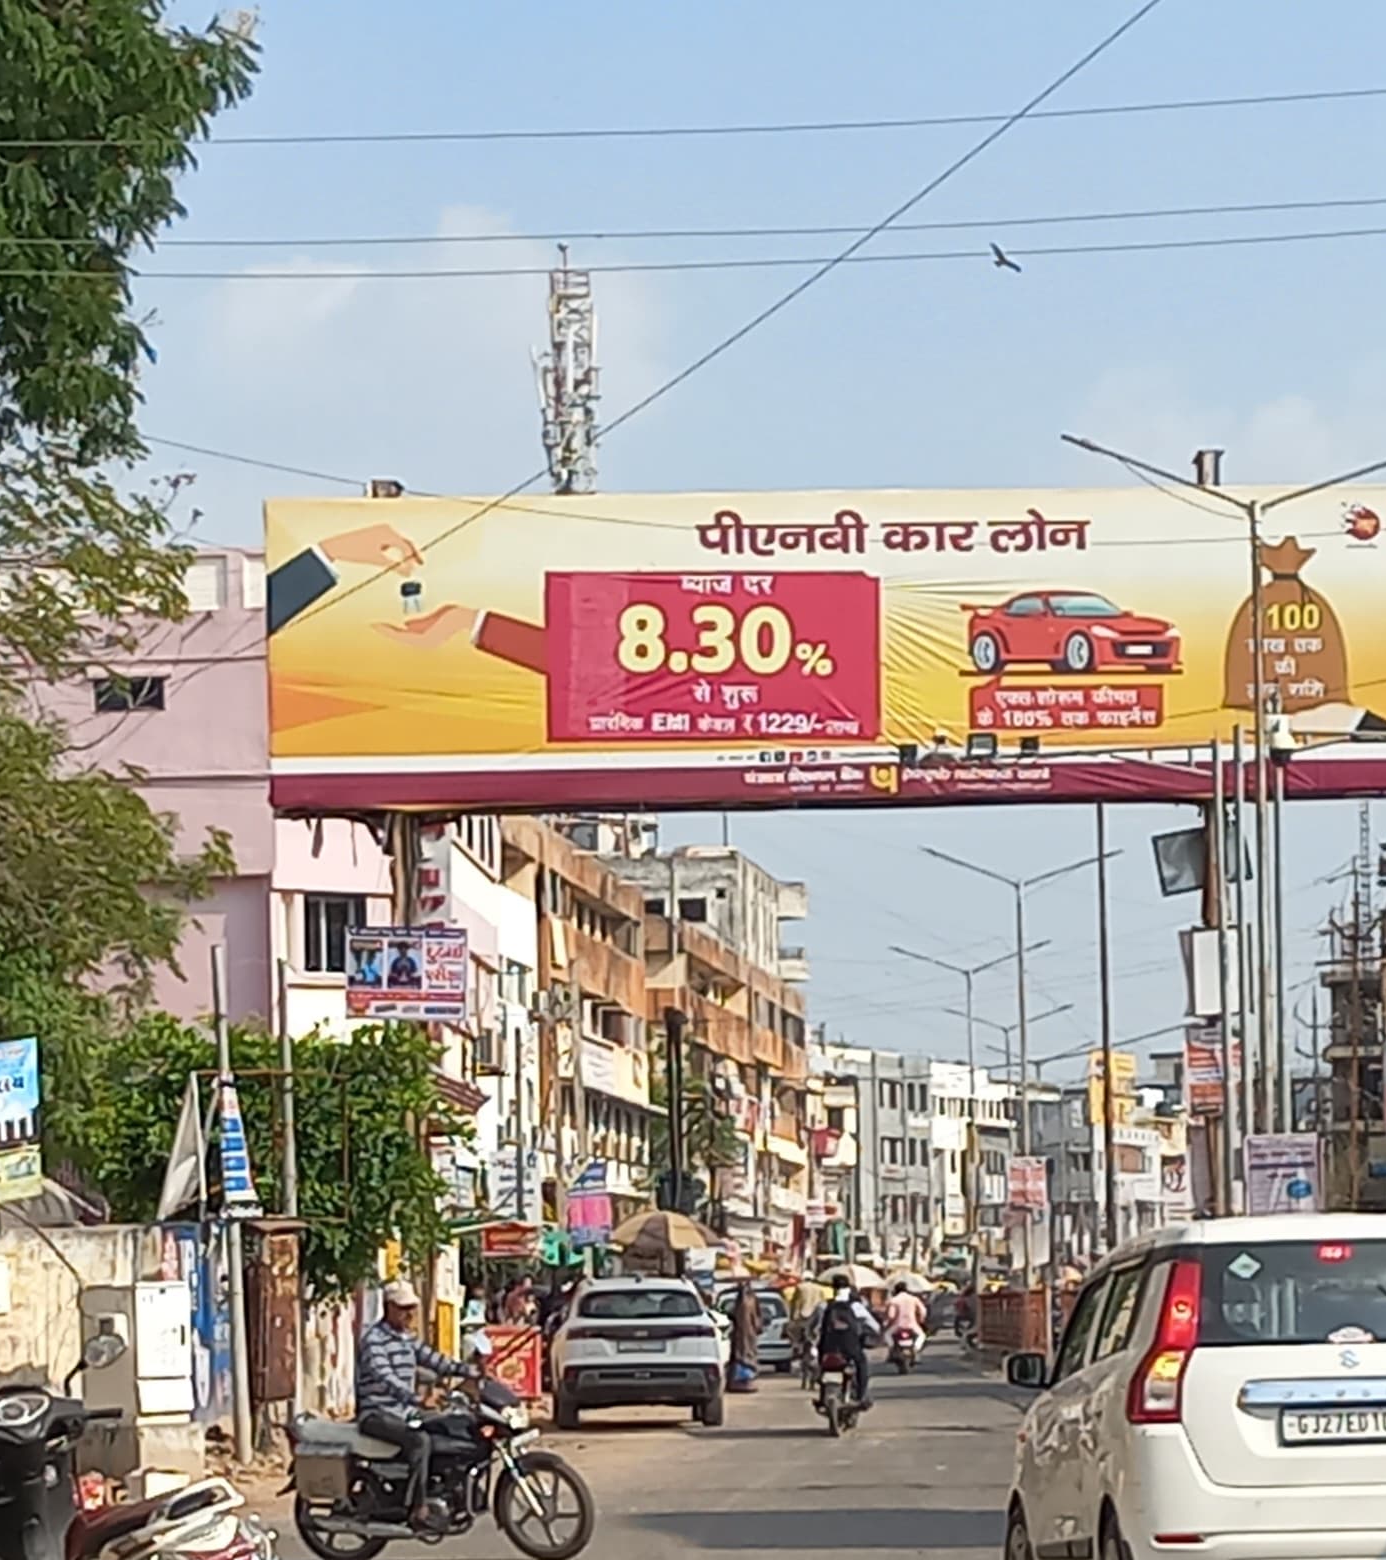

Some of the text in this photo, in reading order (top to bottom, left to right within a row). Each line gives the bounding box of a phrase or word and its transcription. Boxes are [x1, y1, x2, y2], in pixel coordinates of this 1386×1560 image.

[695, 508, 1090, 556] पीएनबी कार लोन
[1267, 603, 1321, 631] 100
[650, 712, 690, 733] EMI
[1002, 709, 1054, 728] 100%
